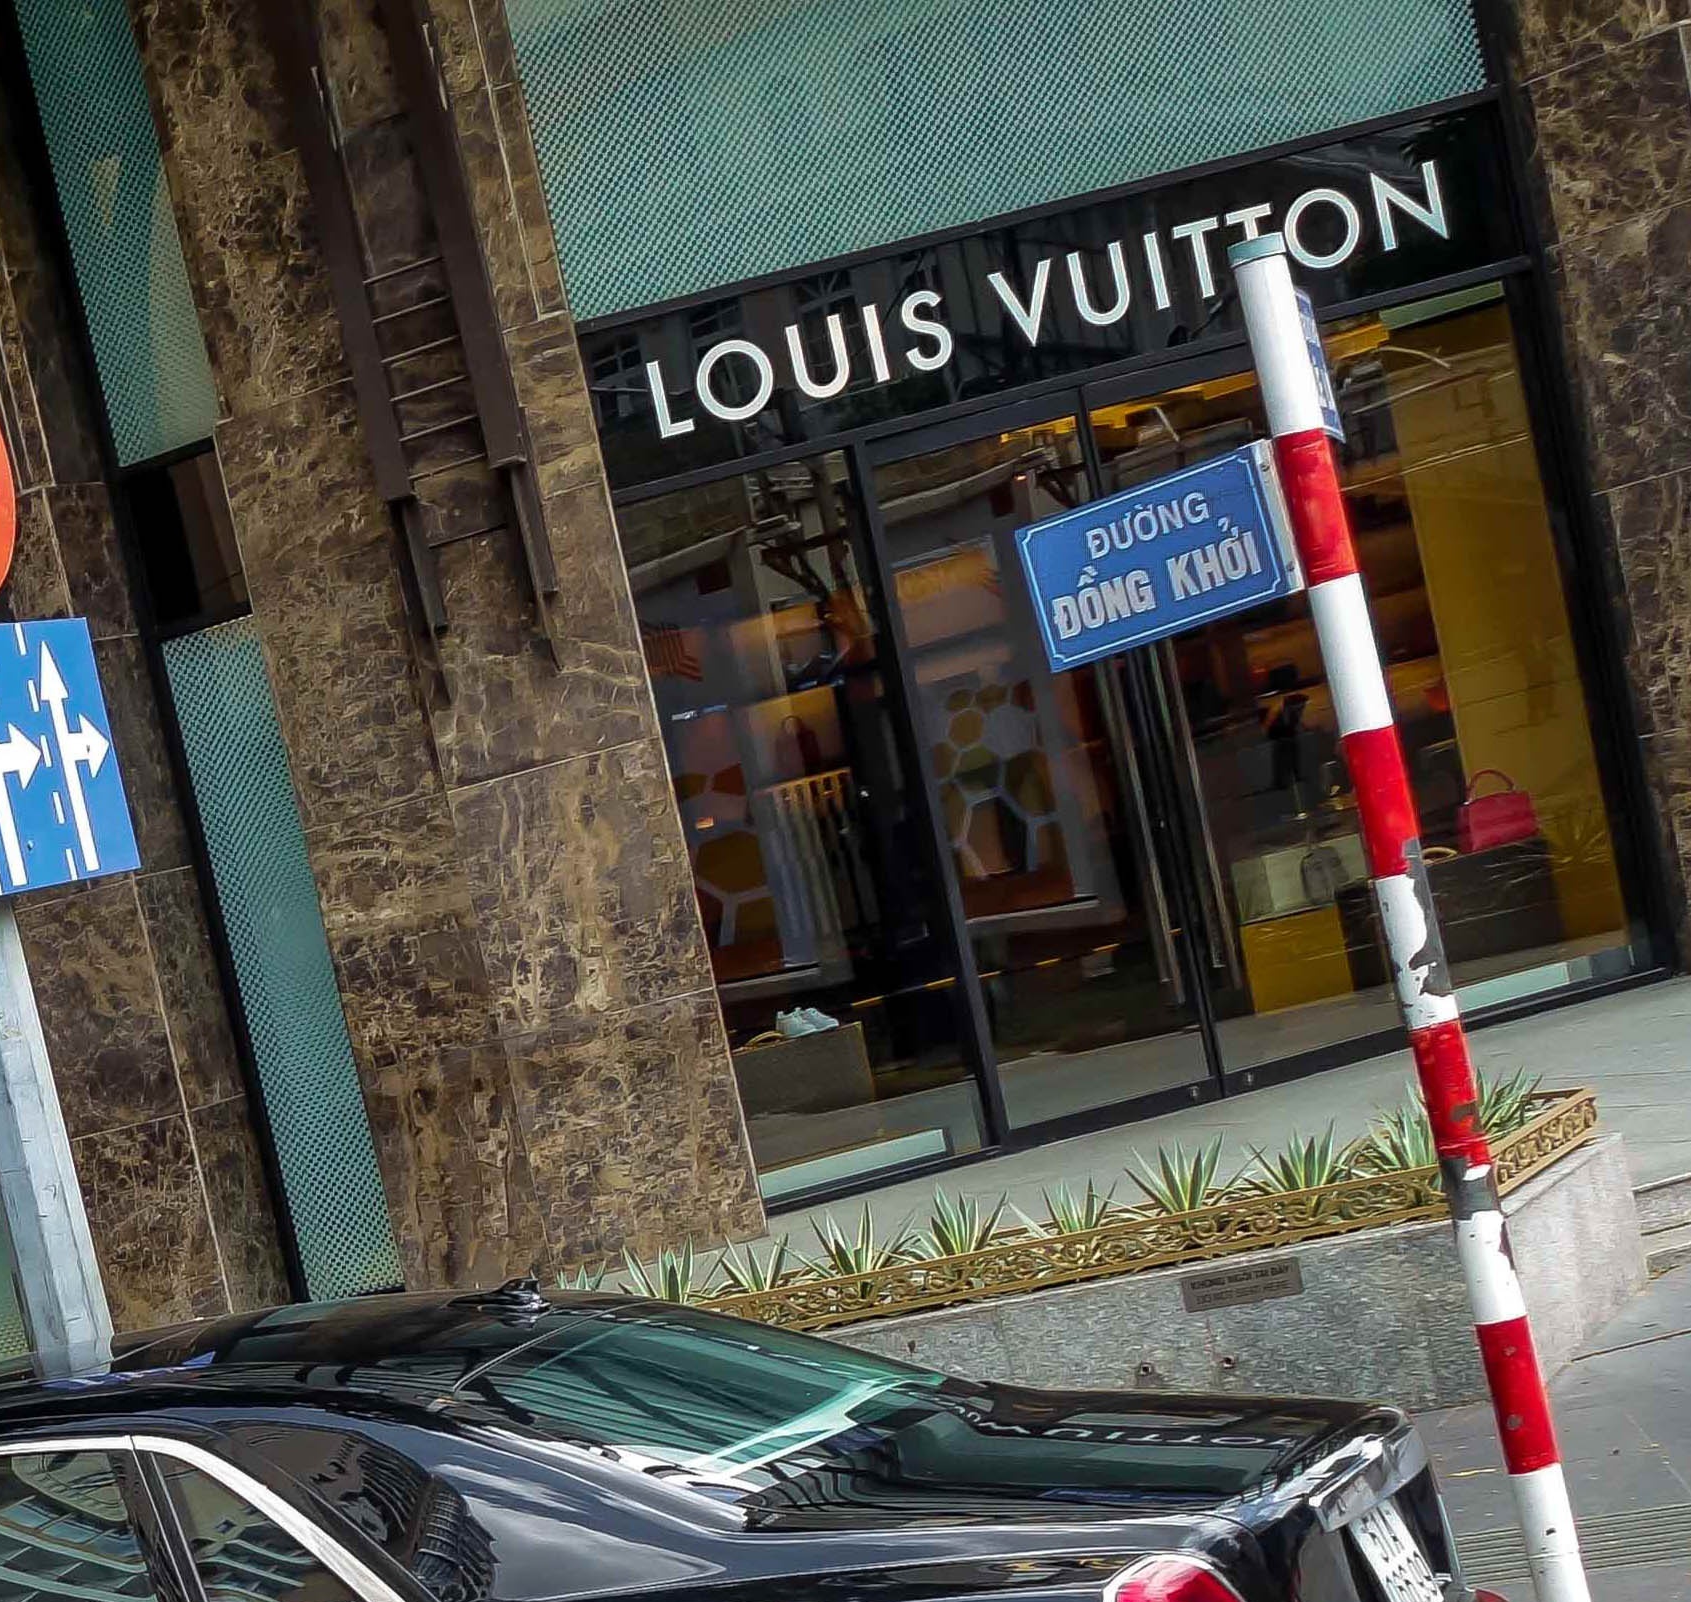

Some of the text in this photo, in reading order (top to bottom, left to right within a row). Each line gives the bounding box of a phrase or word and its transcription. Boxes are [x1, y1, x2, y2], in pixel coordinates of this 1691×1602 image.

[646, 160, 1450, 439] LOUIS VUITTON
[1053, 516, 1261, 640] ĐỒNG KHỞI
[1085, 492, 1210, 559] ĐƯỜNG
